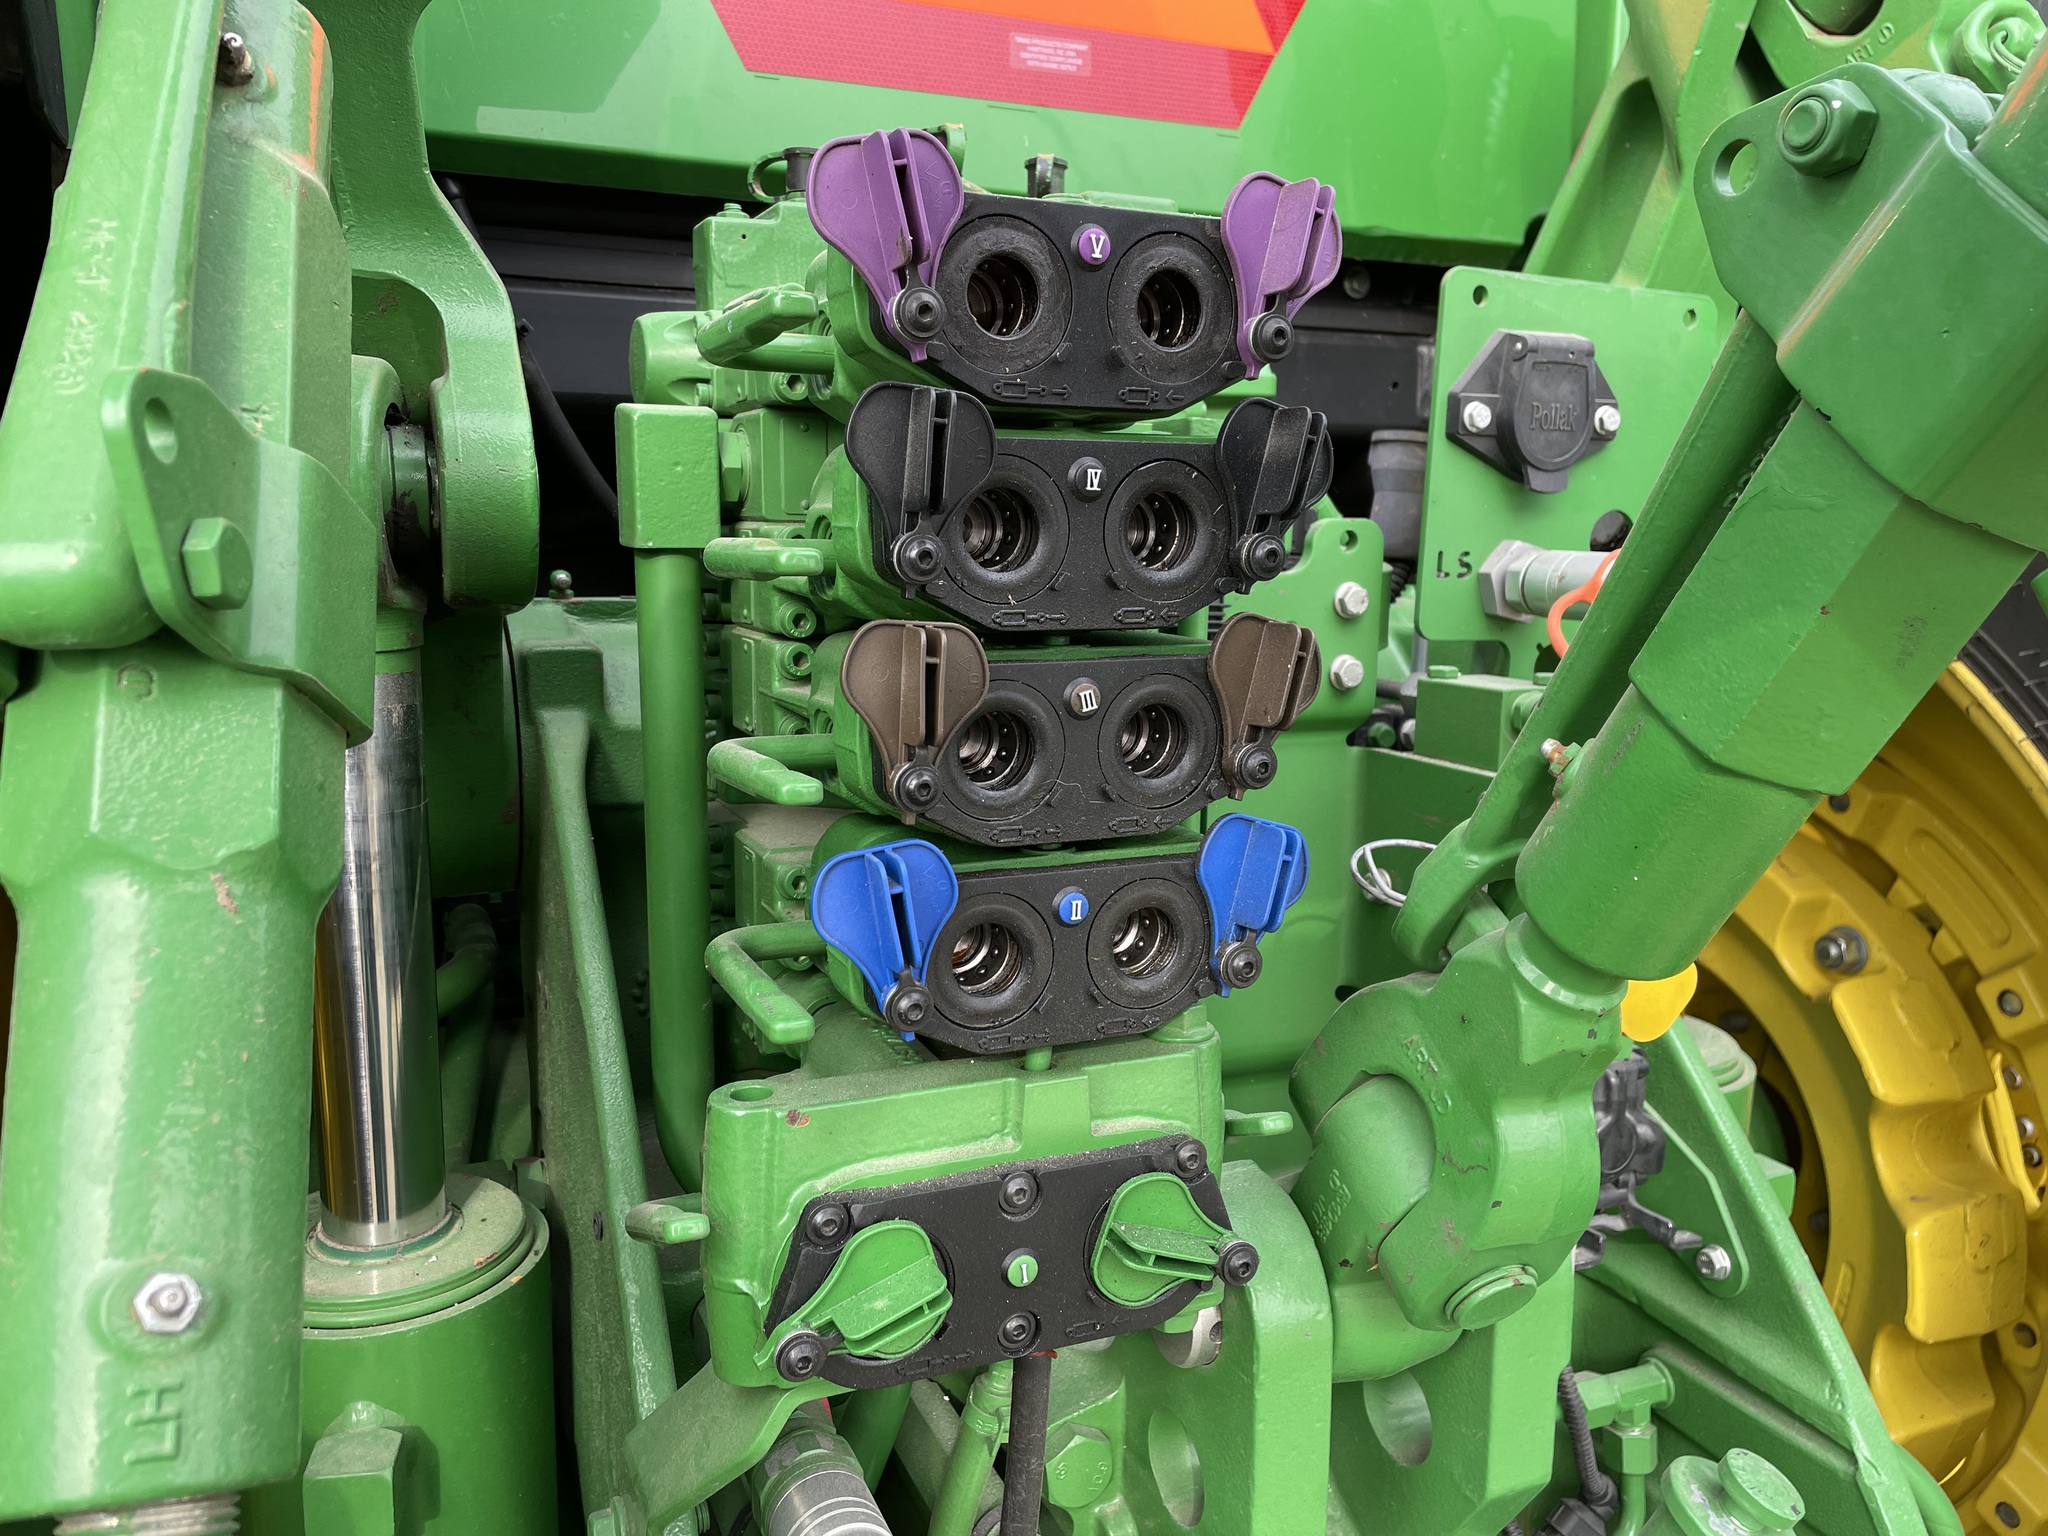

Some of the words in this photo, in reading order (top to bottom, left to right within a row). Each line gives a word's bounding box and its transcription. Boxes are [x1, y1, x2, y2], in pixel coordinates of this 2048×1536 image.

[1090, 233, 1105, 258] V
[1529, 402, 1577, 432] Pollak
[1086, 468, 1102, 491] IV
[1079, 690, 1098, 712] III
[1070, 899, 1083, 920] II
[1021, 1263, 1029, 1284] I
[122, 1381, 185, 1466] LH
